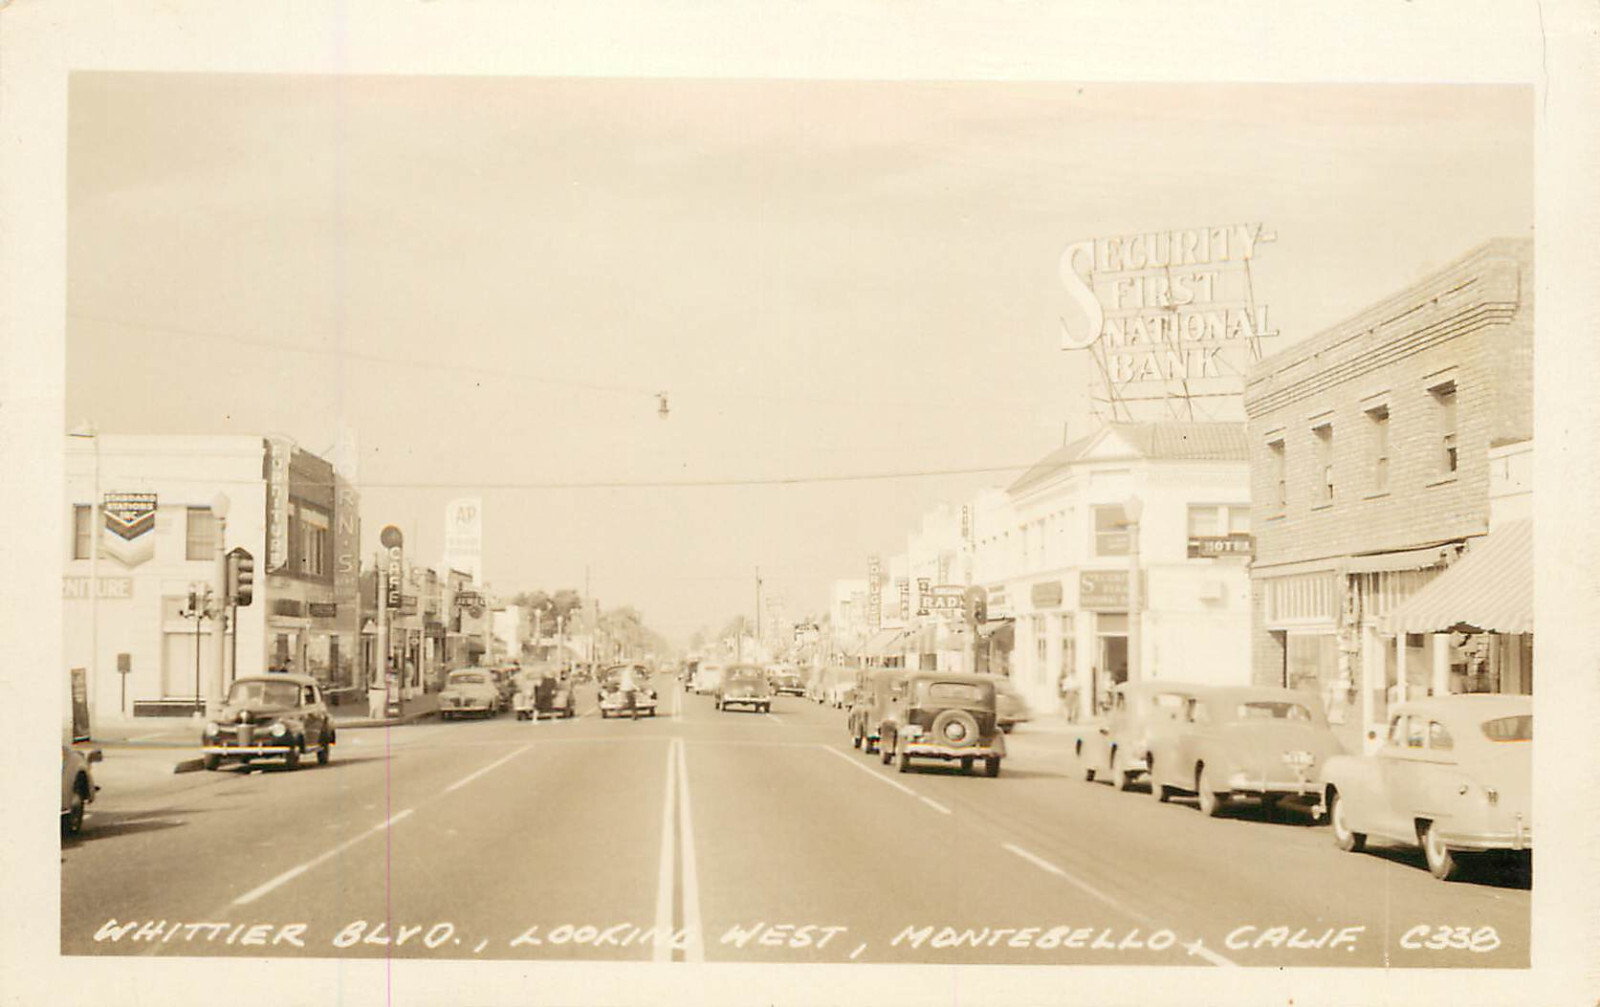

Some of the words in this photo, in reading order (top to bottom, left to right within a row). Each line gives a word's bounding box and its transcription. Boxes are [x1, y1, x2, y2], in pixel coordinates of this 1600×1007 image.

[1112, 272, 1219, 309] FIRST
[1102, 304, 1280, 349] NATIONAL
[1109, 346, 1222, 383] BANK
[104, 494, 156, 502] STANDARD
[106, 502, 154, 511] STATIONS
[1204, 540, 1250, 552] HOTEL
[388, 546, 401, 604] CAFE
[922, 596, 960, 608] RAD
